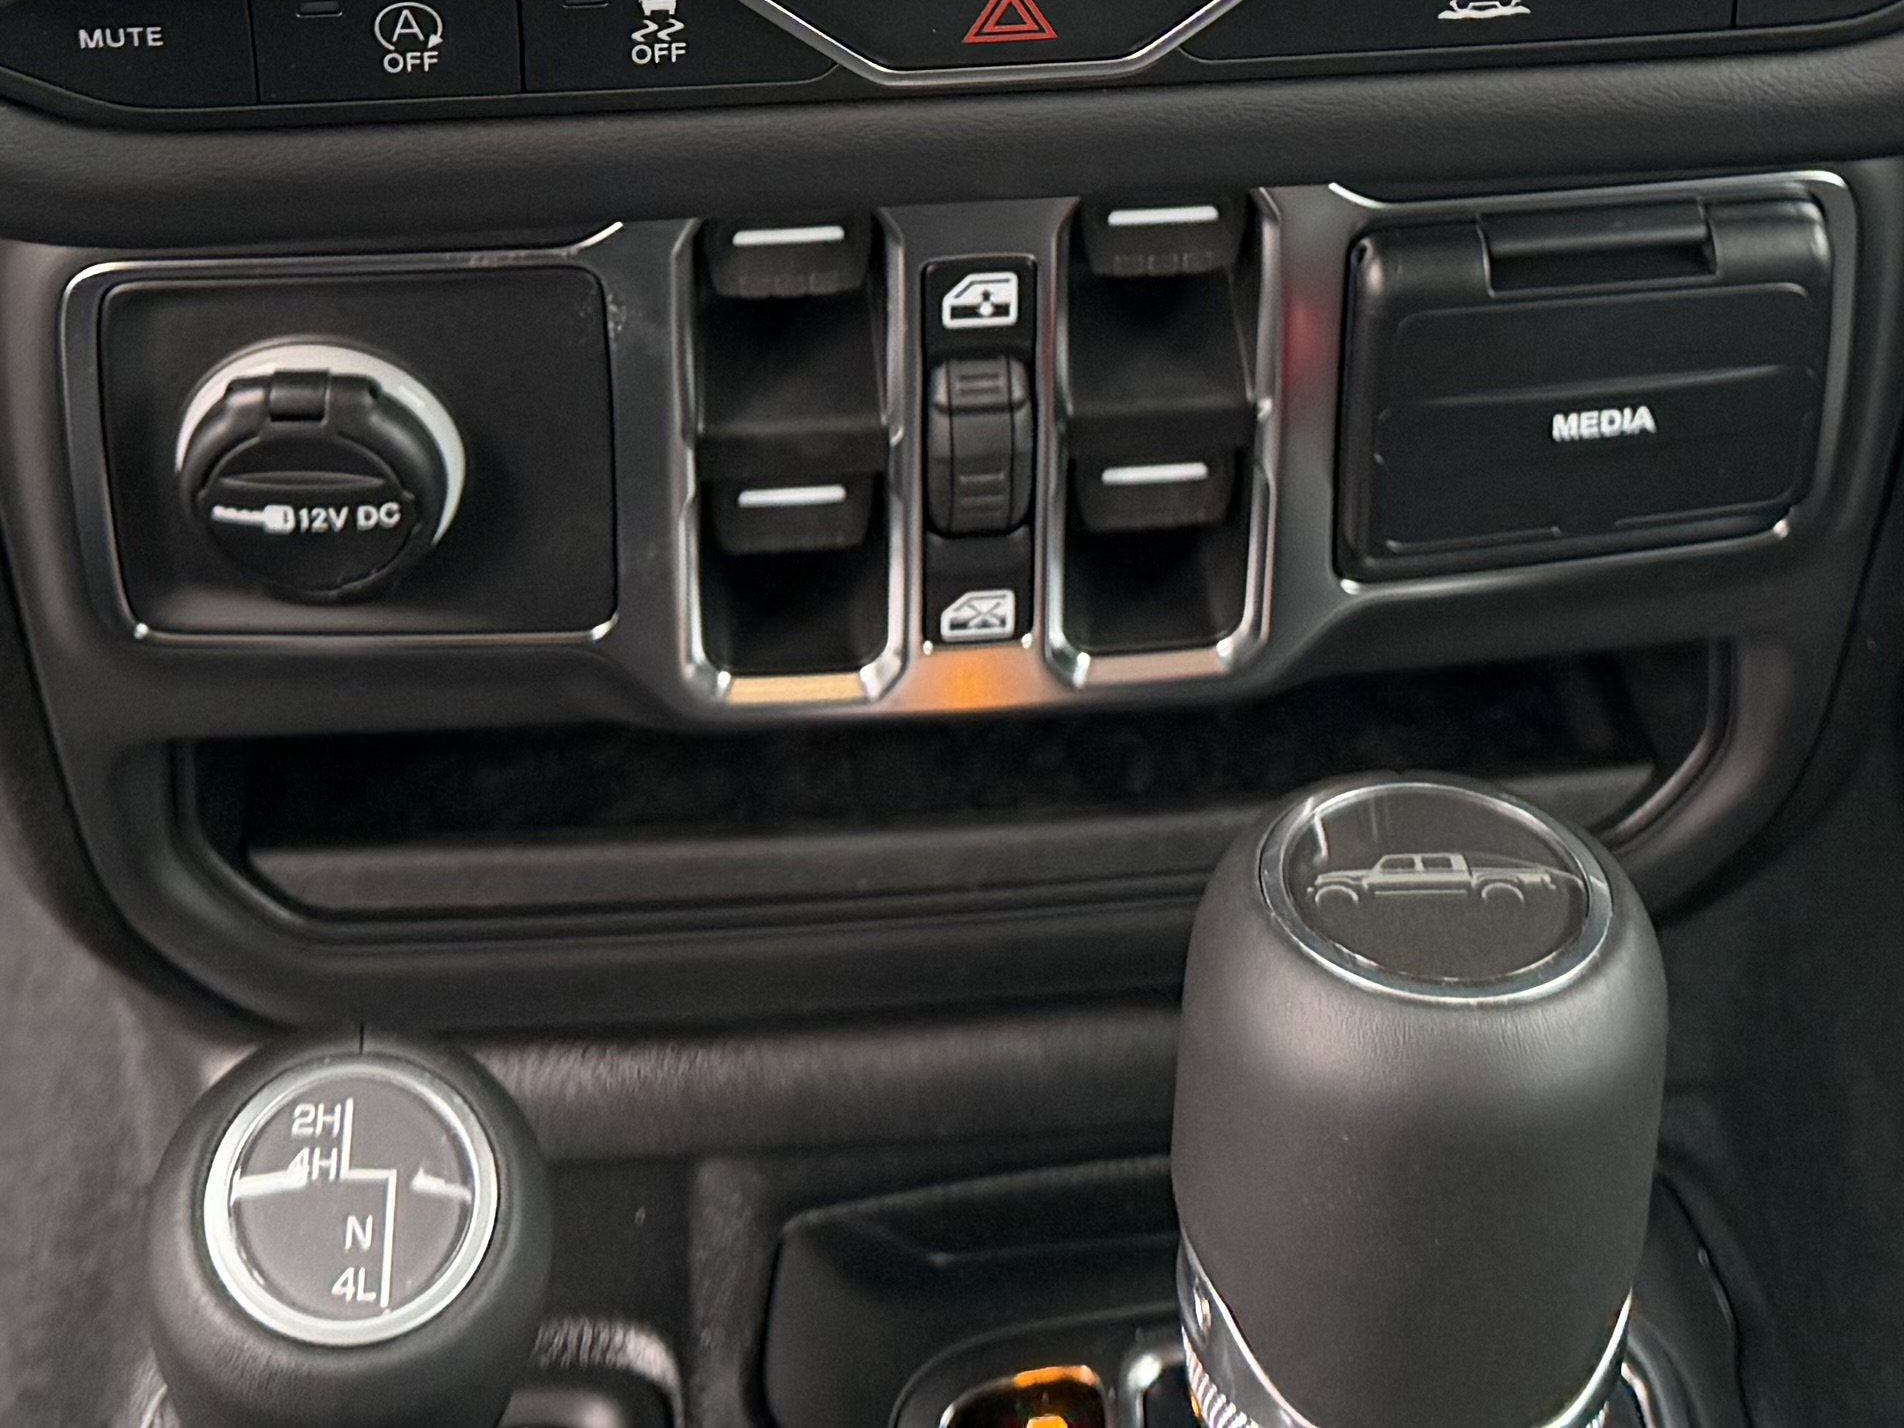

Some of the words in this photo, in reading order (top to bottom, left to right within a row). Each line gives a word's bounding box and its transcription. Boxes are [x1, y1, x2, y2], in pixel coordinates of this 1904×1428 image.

[78, 26, 164, 49] MUTE
[631, 42, 686, 64] OFF
[383, 51, 438, 72] OFF
[1552, 405, 1655, 442] MEDIA
[298, 507, 348, 531] 12V
[356, 502, 401, 530] DC
[291, 1103, 341, 1138] 2H
[287, 1147, 338, 1182] 4H
[345, 1215, 373, 1252] N
[331, 1267, 376, 1302] 4L
